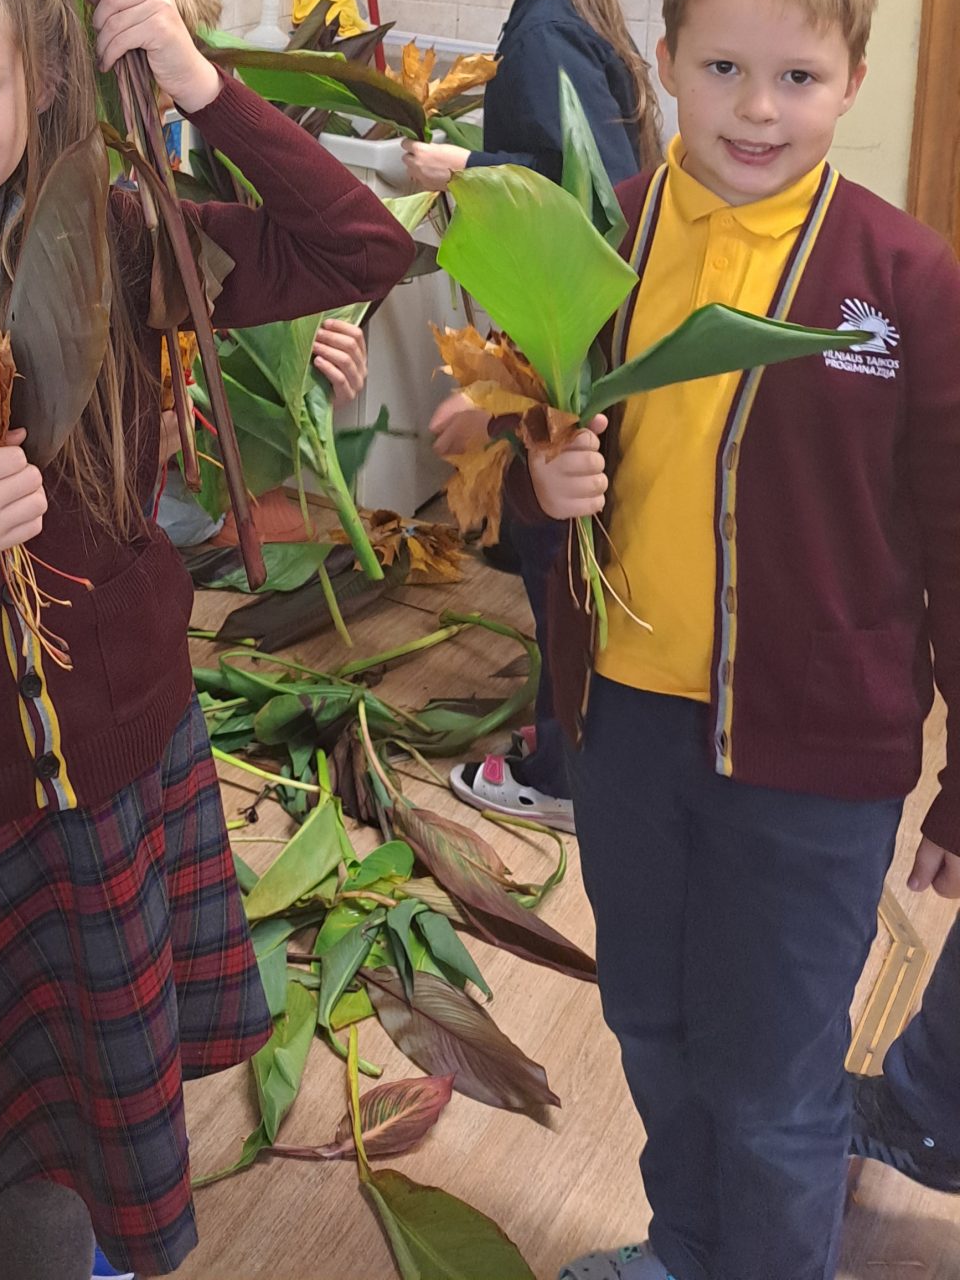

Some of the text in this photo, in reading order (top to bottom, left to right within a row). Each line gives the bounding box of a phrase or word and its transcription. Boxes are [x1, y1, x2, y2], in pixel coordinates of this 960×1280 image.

[823, 349, 900, 369] VILNIAUS TAIKOS
[824, 358, 896, 379] PROGIMNAZIJA
